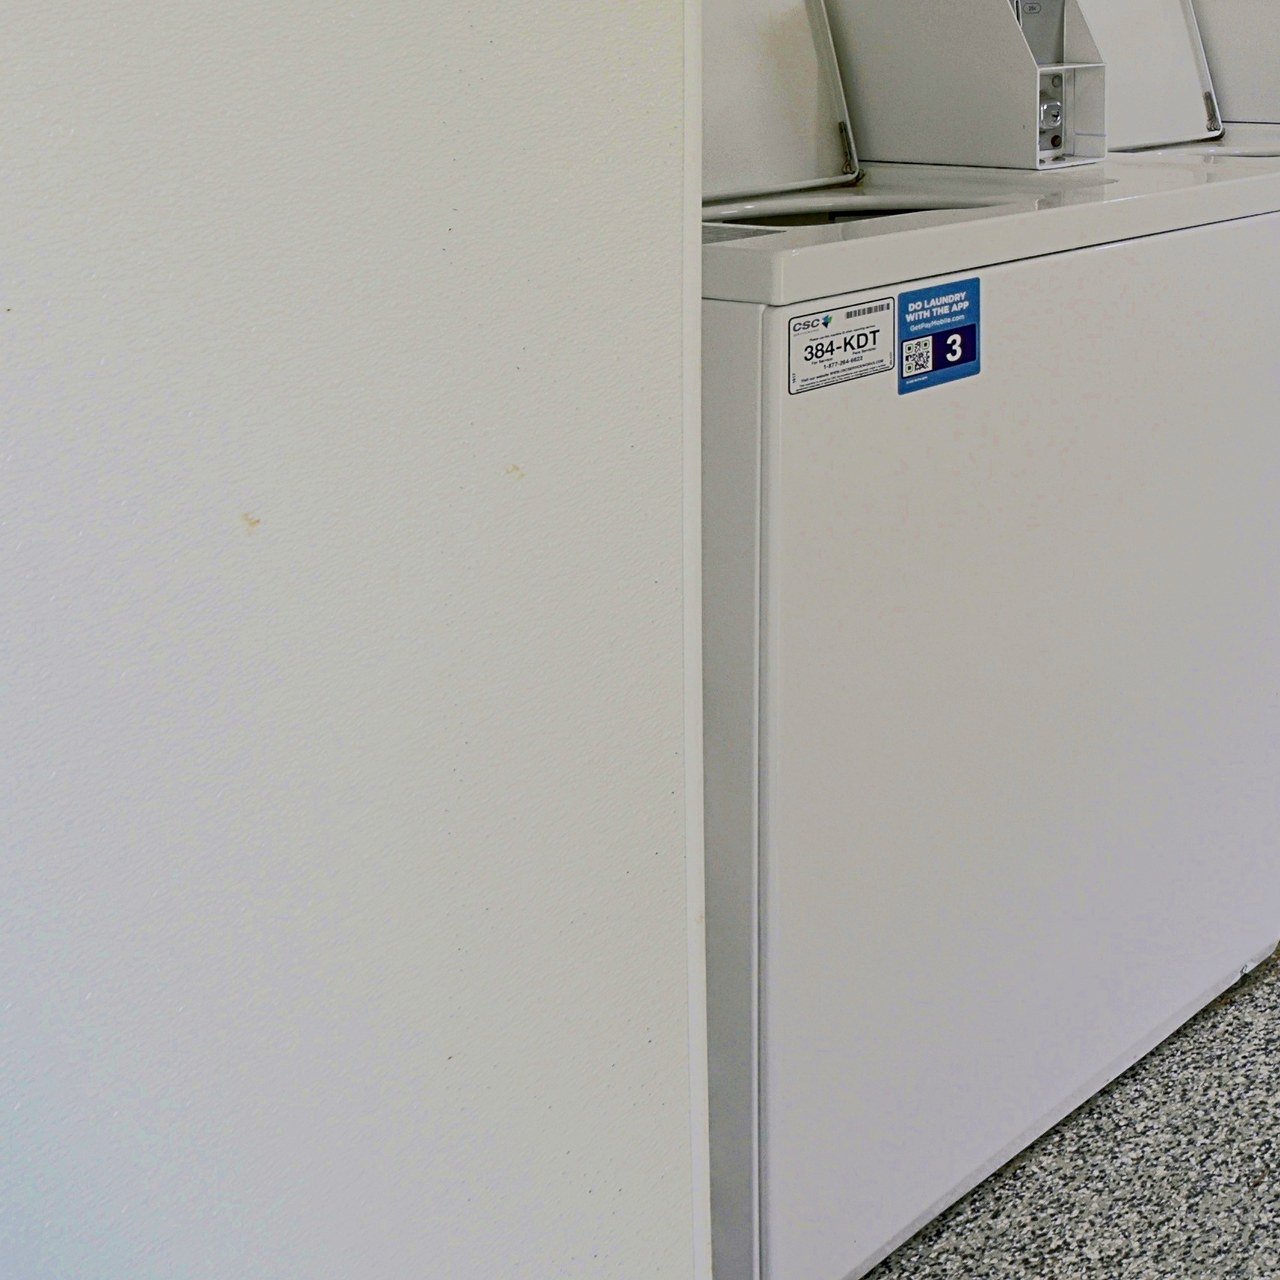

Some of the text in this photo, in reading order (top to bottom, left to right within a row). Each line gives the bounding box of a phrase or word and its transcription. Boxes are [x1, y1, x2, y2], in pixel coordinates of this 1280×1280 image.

[905, 300, 970, 322] WITH THE APP
[908, 290, 967, 312] DO LAUNDRY
[793, 318, 820, 332] CSC
[910, 314, 965, 332] GetPayMobile.com
[804, 329, 880, 361] 384-KDT
[946, 333, 962, 362] 3
